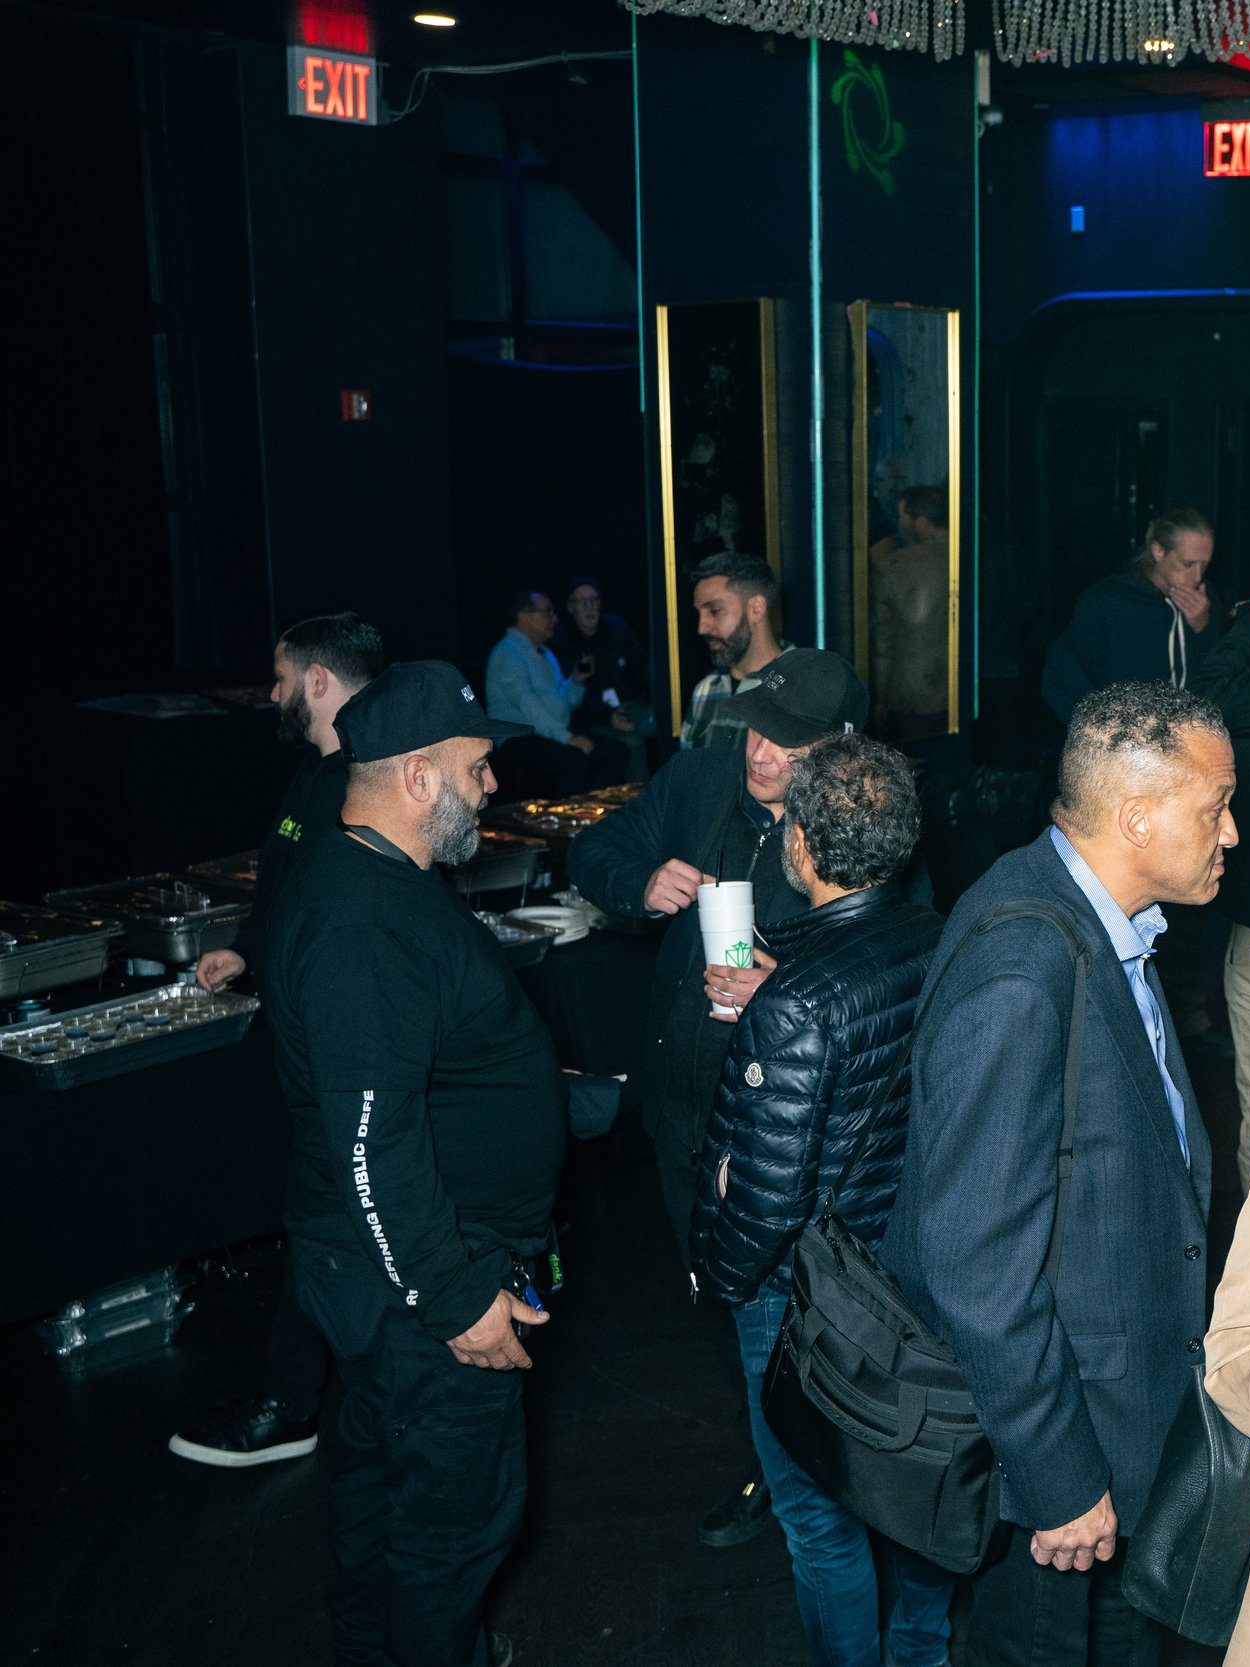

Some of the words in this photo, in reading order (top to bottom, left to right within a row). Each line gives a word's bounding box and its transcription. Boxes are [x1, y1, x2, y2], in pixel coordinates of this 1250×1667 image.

[305, 55, 370, 121] EXIT
[352, 1142, 375, 1209] PUBLIC
[366, 1212, 419, 1306] REFINING
